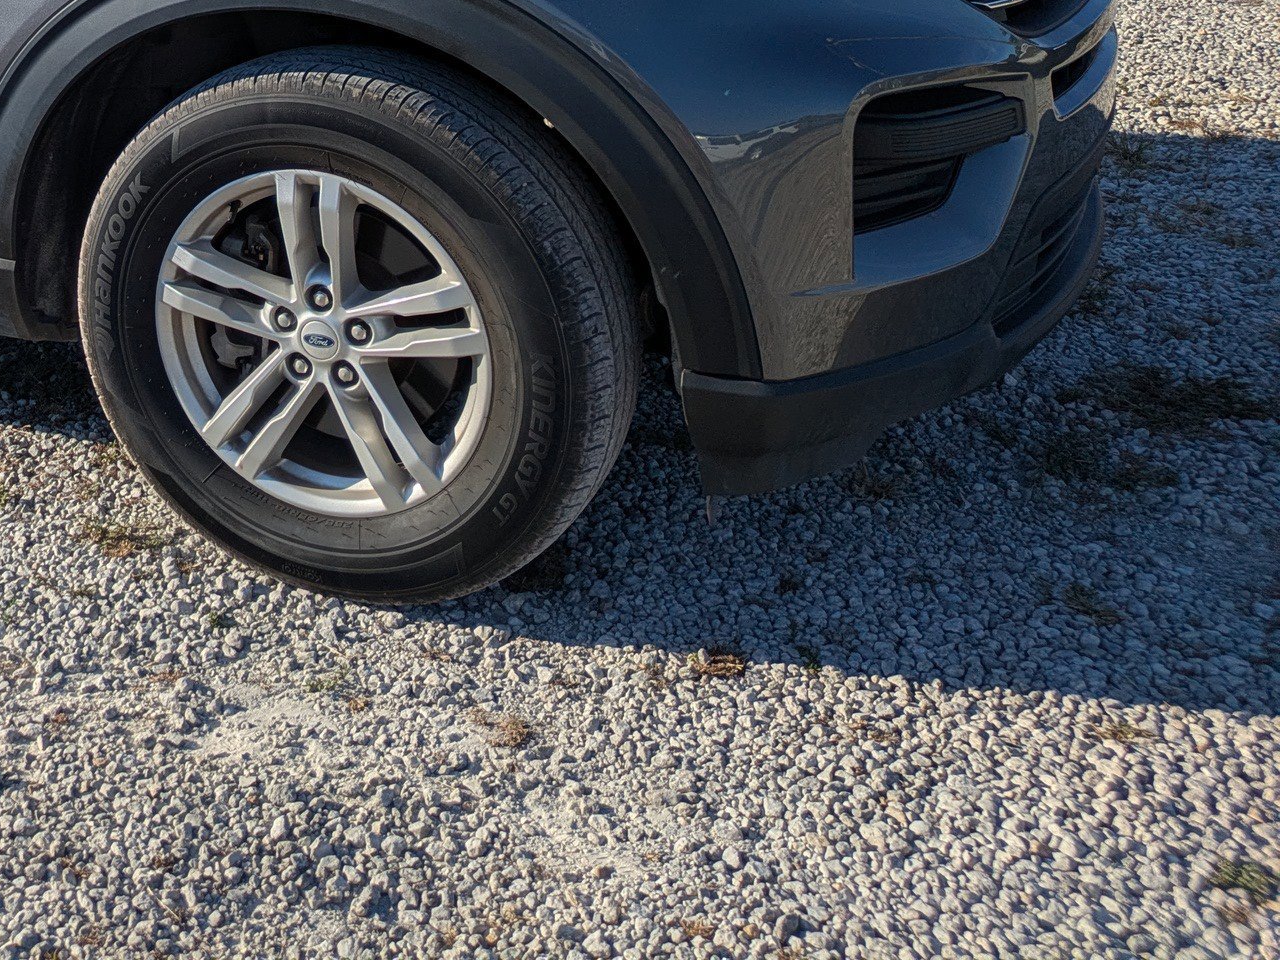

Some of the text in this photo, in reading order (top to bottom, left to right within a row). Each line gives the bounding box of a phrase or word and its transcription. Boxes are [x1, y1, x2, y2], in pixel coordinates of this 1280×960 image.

[308, 335, 329, 346] Ford
[492, 353, 556, 528] KINERGY GT
